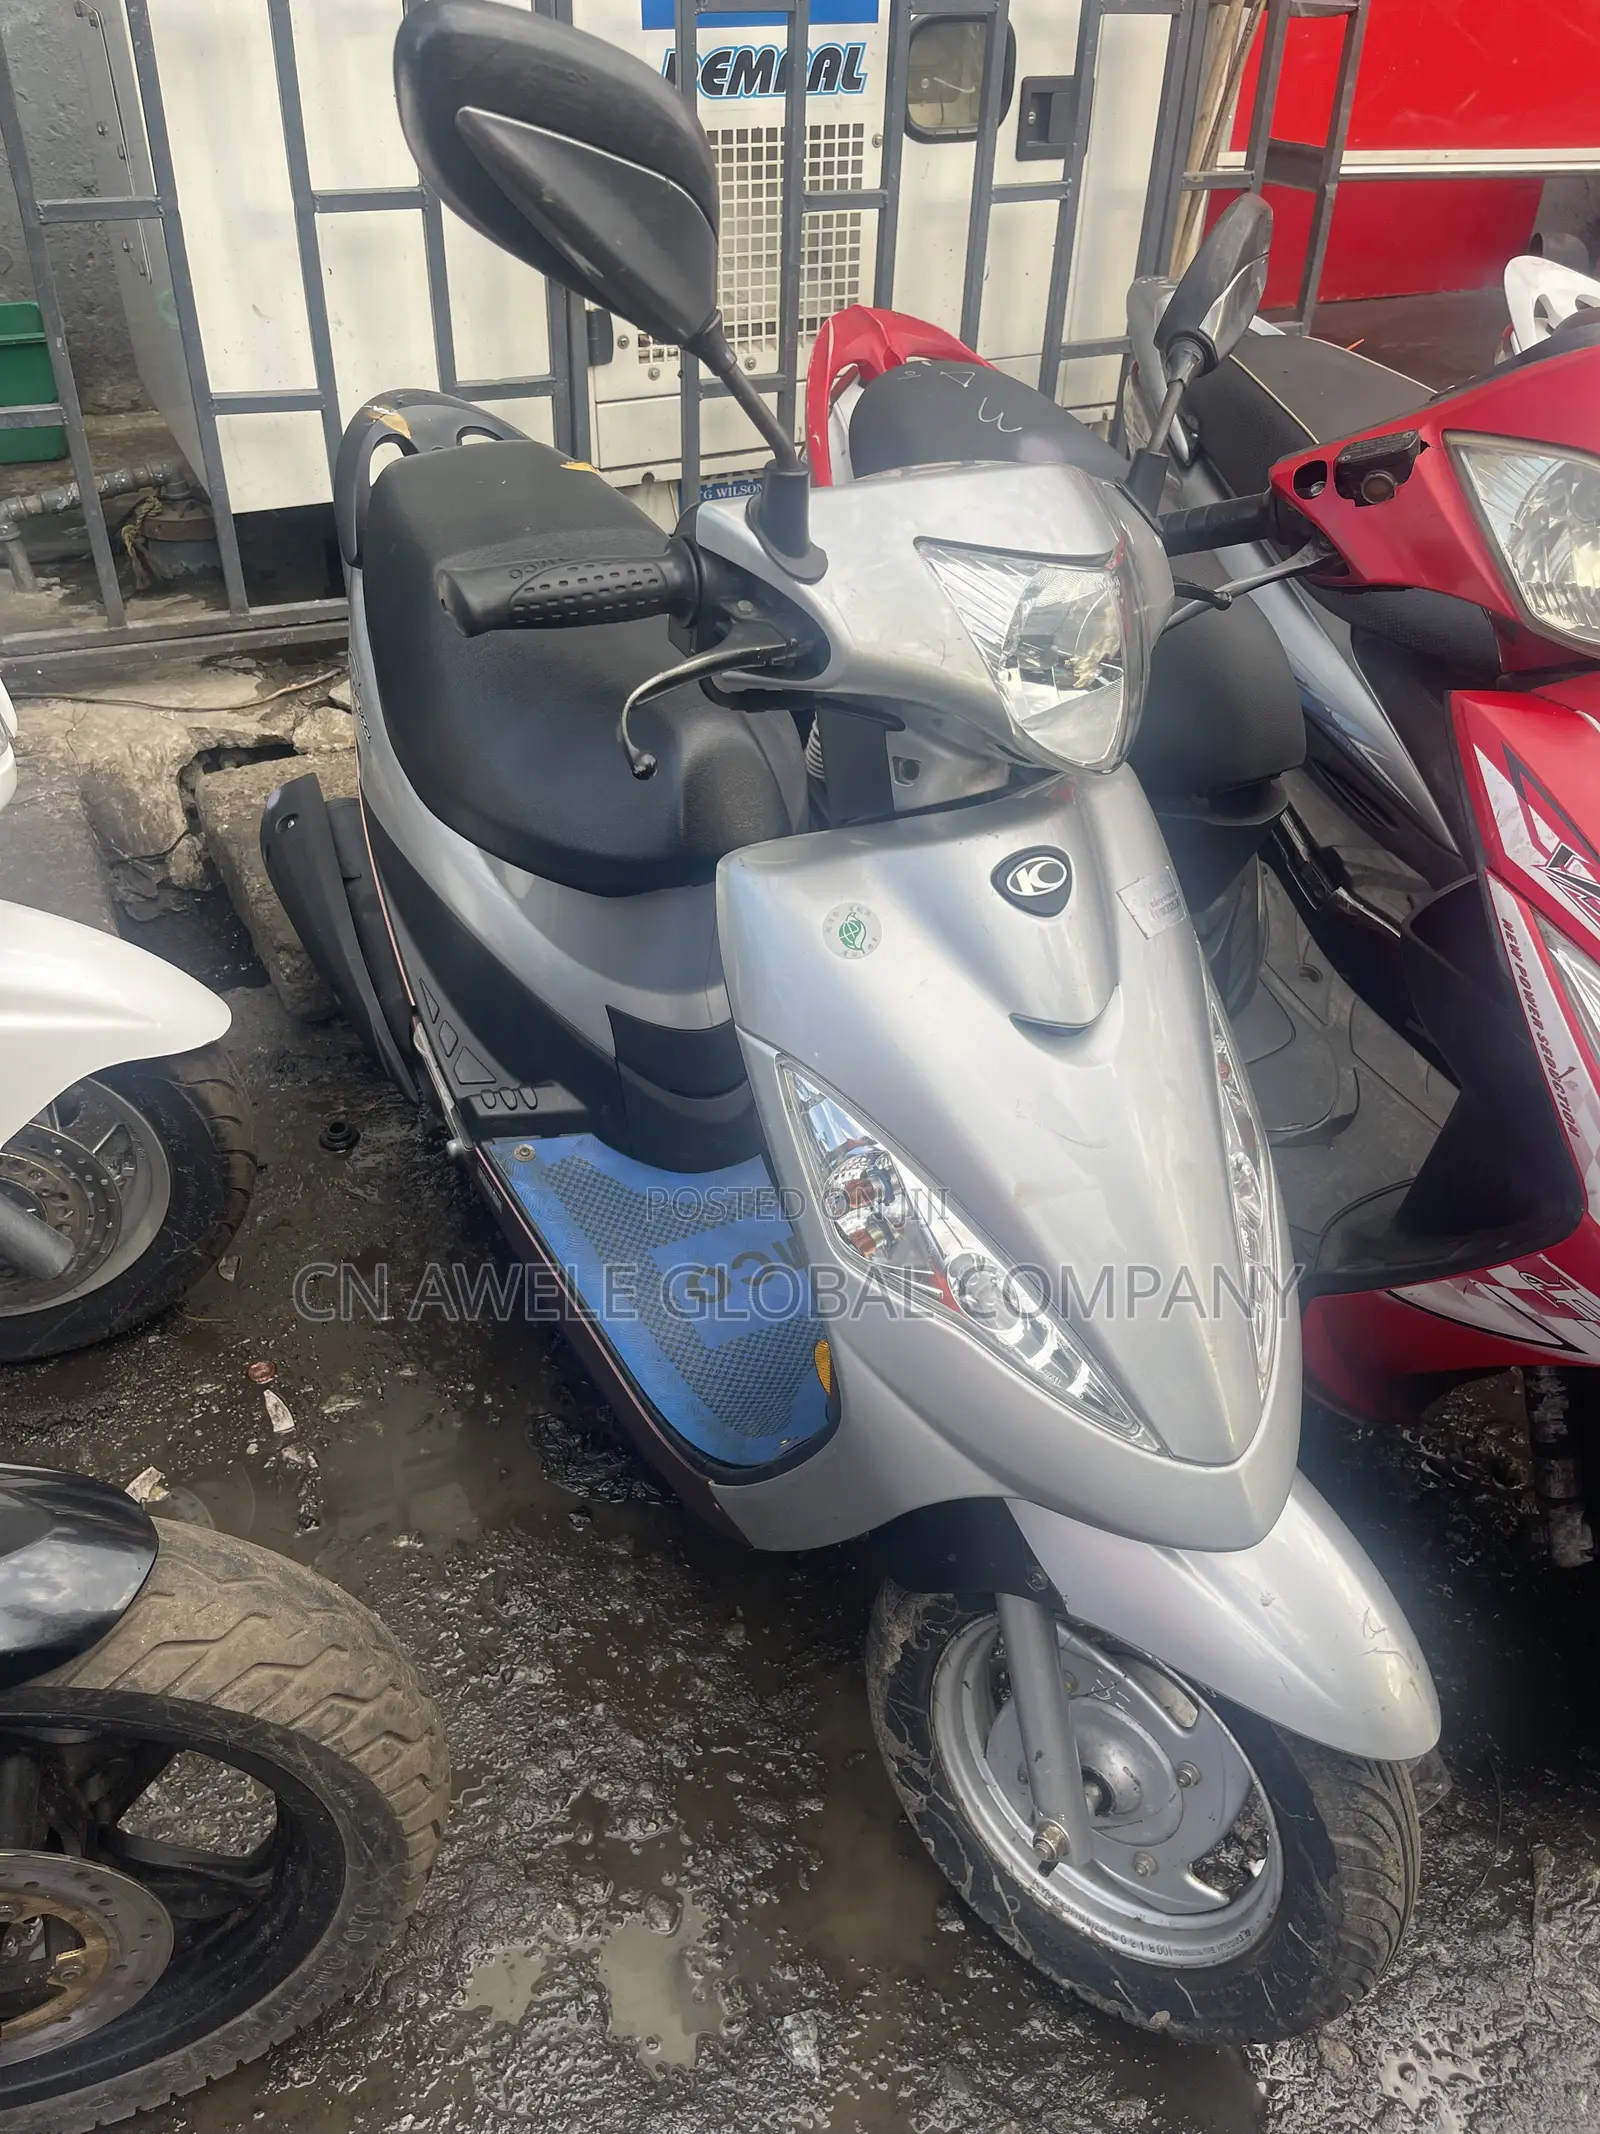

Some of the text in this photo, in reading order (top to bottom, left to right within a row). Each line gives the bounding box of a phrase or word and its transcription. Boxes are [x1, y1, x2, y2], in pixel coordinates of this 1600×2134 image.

[662, 42, 867, 99] EMAL
[1502, 918, 1580, 1138] NEW POWER SEDUCTION
